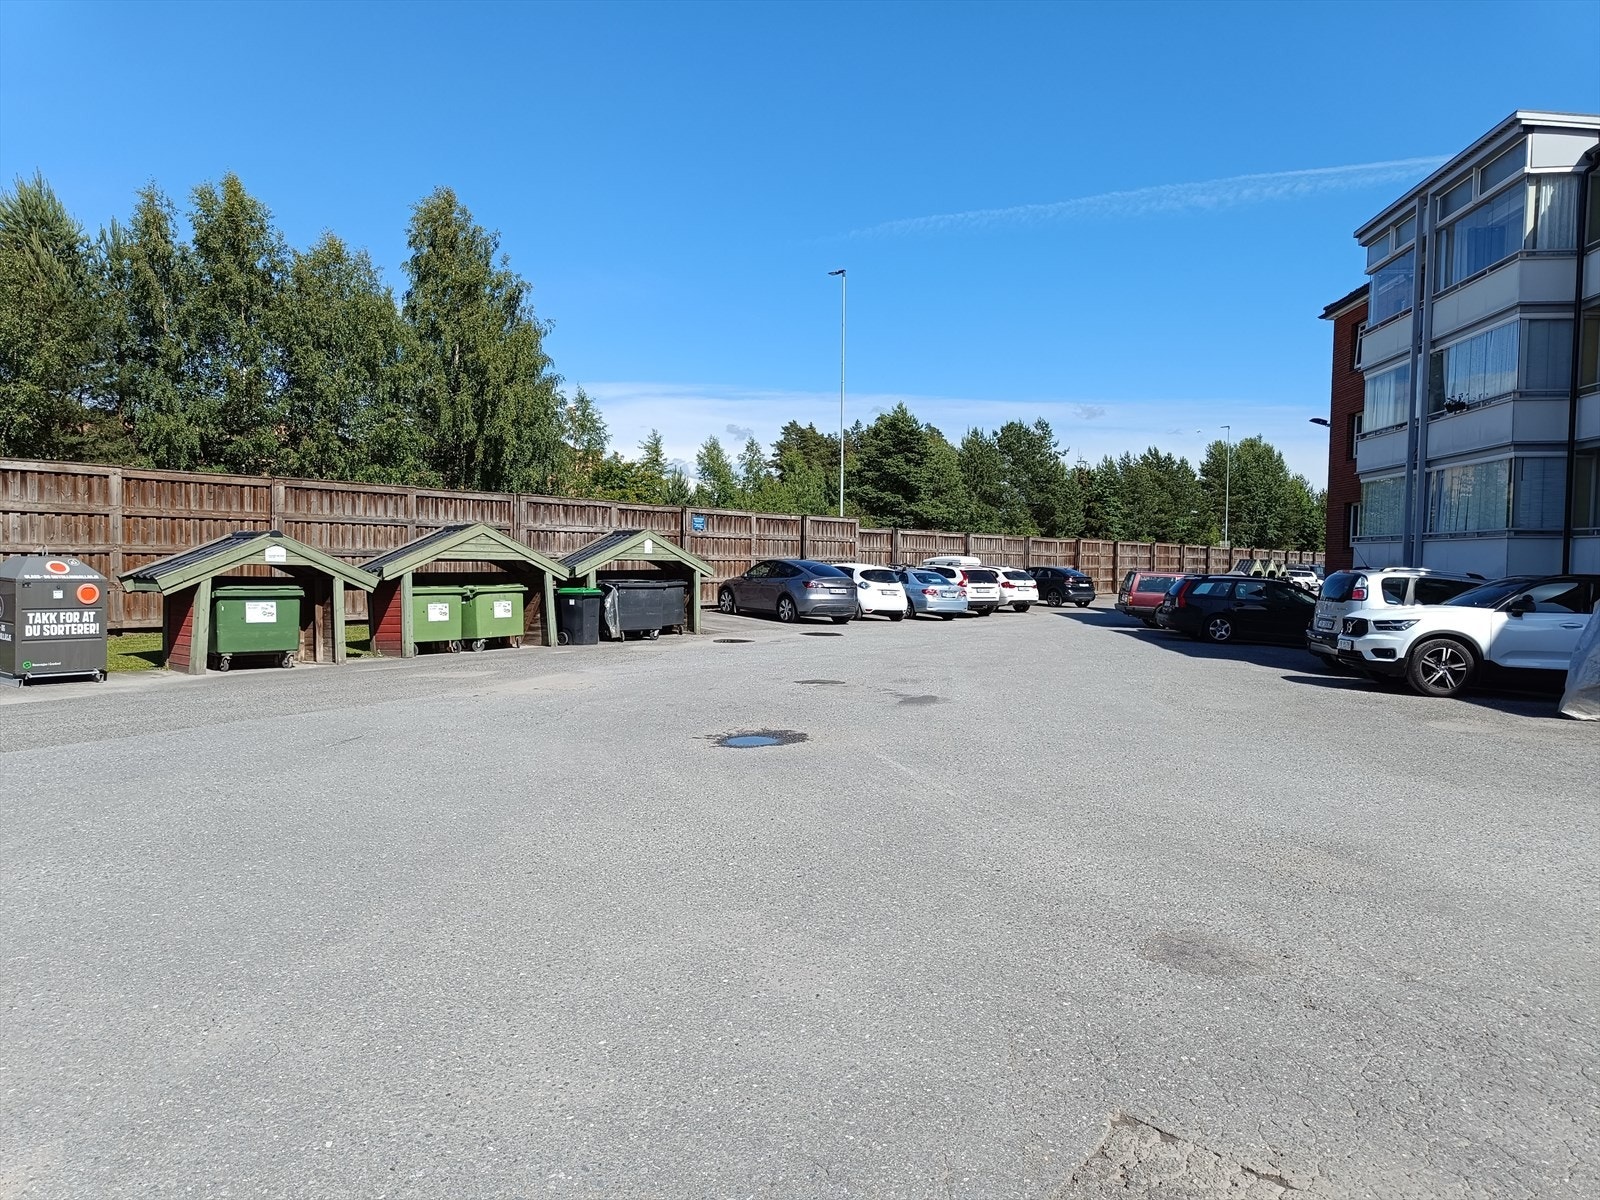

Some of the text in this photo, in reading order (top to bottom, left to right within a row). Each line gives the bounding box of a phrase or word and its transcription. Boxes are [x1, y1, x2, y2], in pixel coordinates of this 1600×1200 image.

[27, 611, 96, 624] TAKK FOR AT
[25, 623, 100, 636] DU SORTERER!
